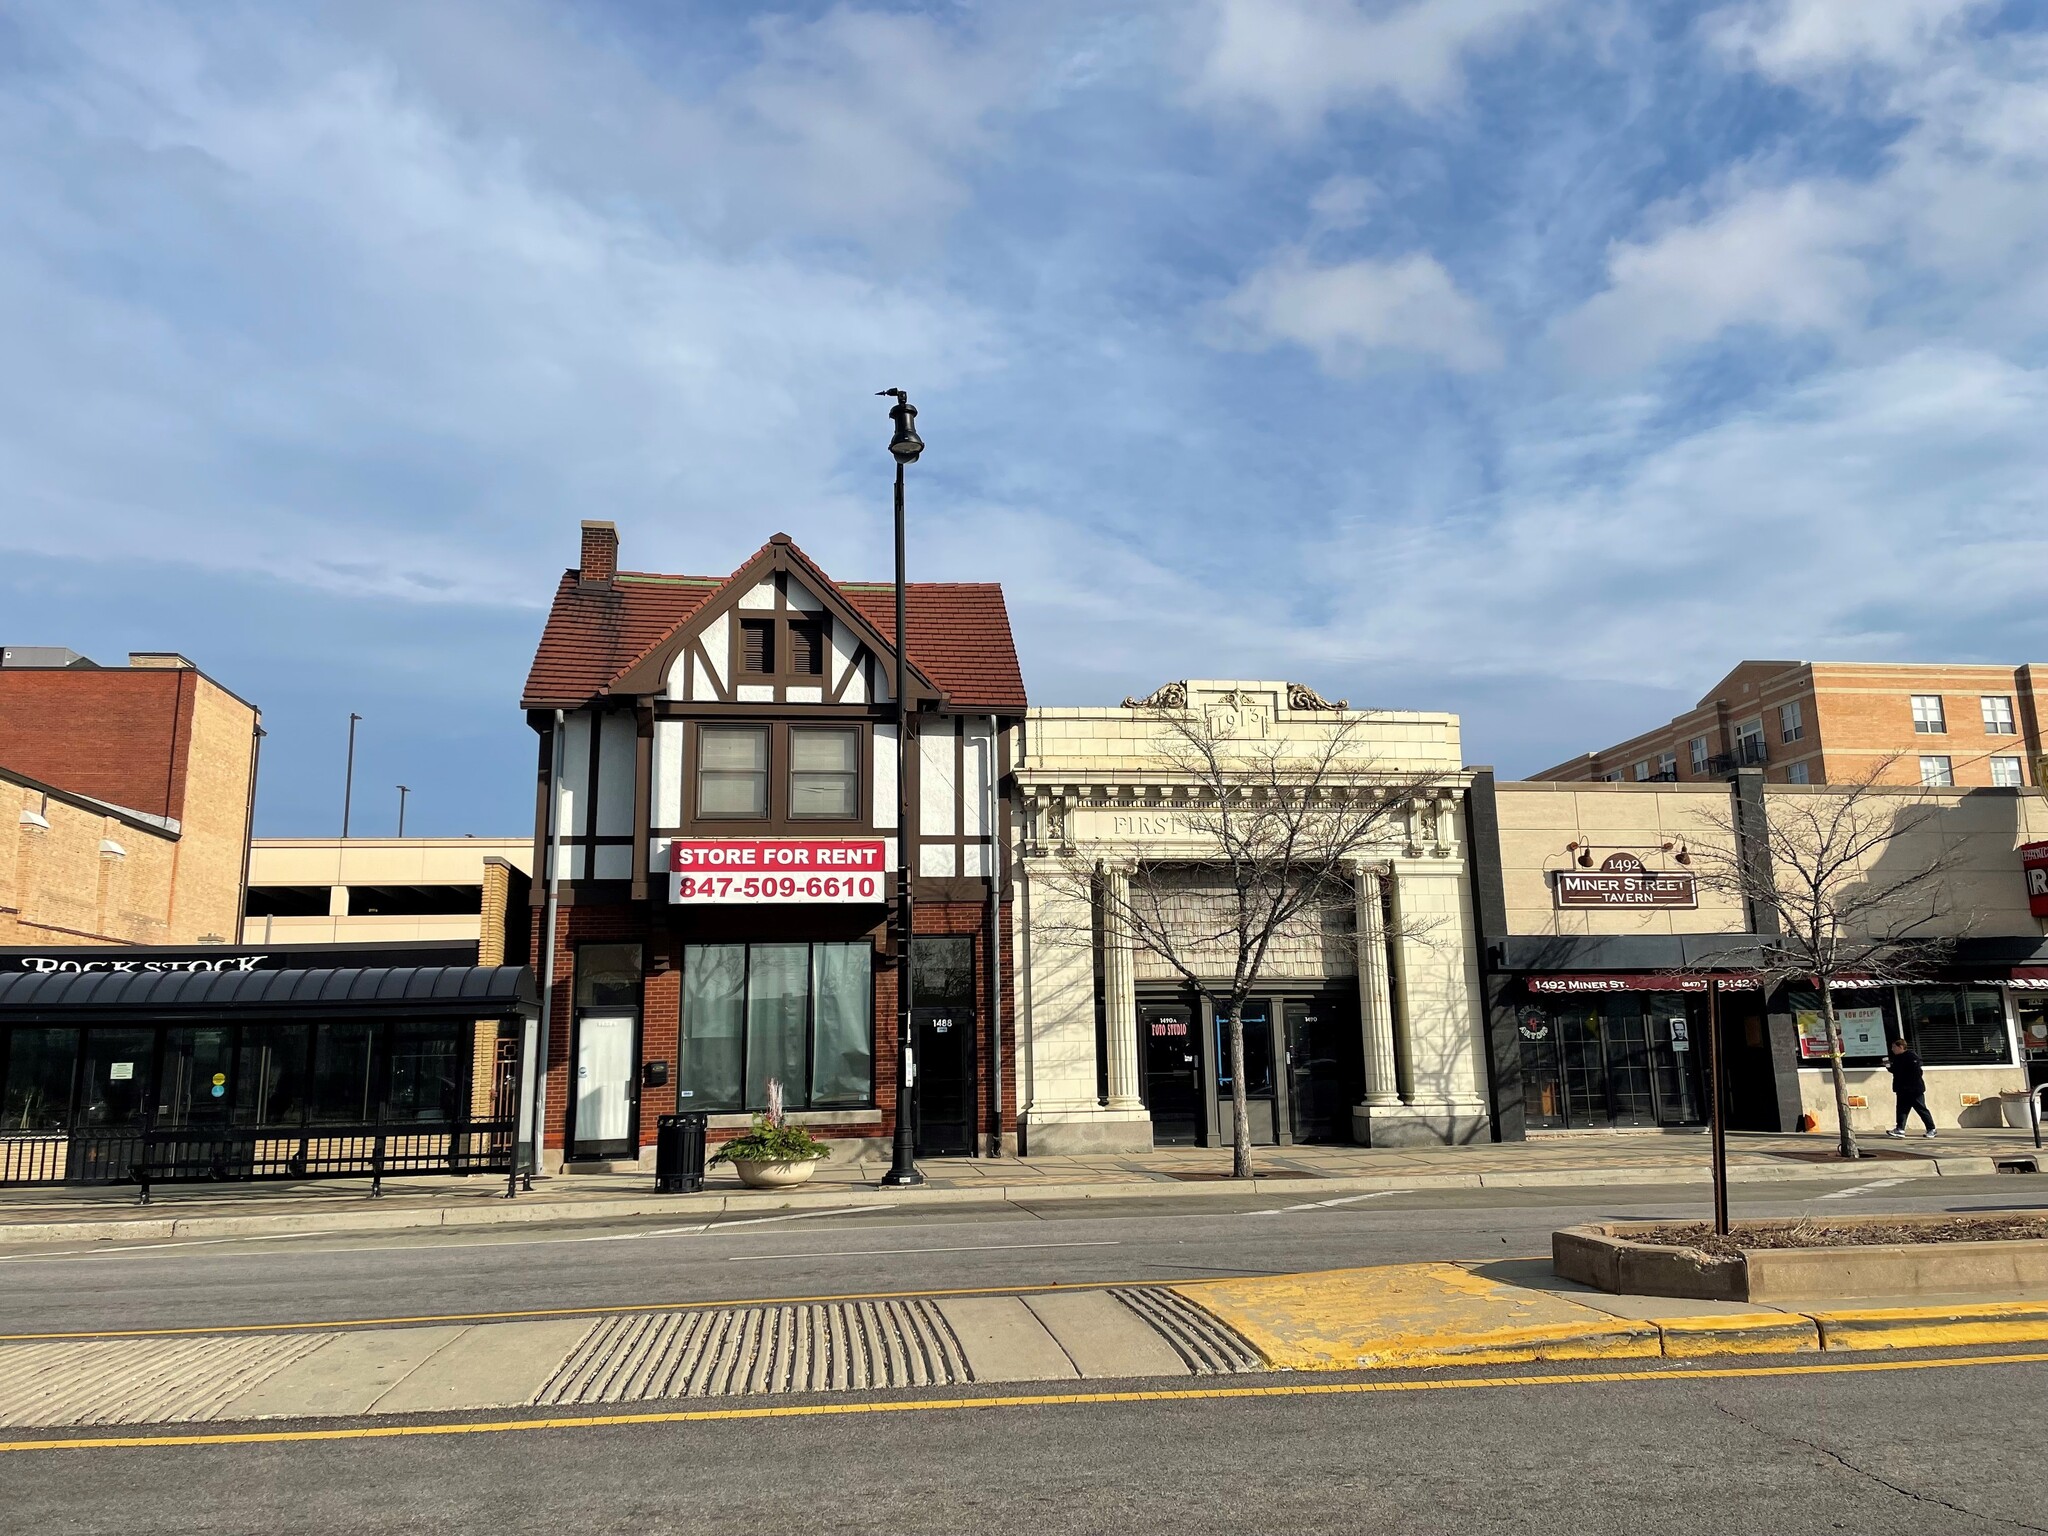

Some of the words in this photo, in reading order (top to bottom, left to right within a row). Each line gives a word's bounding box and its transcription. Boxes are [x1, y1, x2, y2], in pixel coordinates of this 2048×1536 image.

[1217, 707, 1259, 734] 1913
[1113, 816, 1179, 835] FIRST
[679, 848, 756, 865] STORE
[764, 848, 810, 865] FOR
[816, 848, 878, 865] RENT
[1608, 859, 1641, 872] 1492
[679, 877, 875, 898] 847-509-6610
[1565, 877, 1620, 891] MINER
[1624, 877, 1685, 891] STREET
[1601, 892, 1654, 903] TAVERN
[1535, 980, 1566, 990] 1492
[1568, 980, 1607, 990] MINER
[1609, 980, 1630, 989] ST.
[932, 1018, 953, 1028] 1488
[1151, 1024, 1166, 1036] FOTO
[1167, 1023, 1187, 1036] STUDIO
